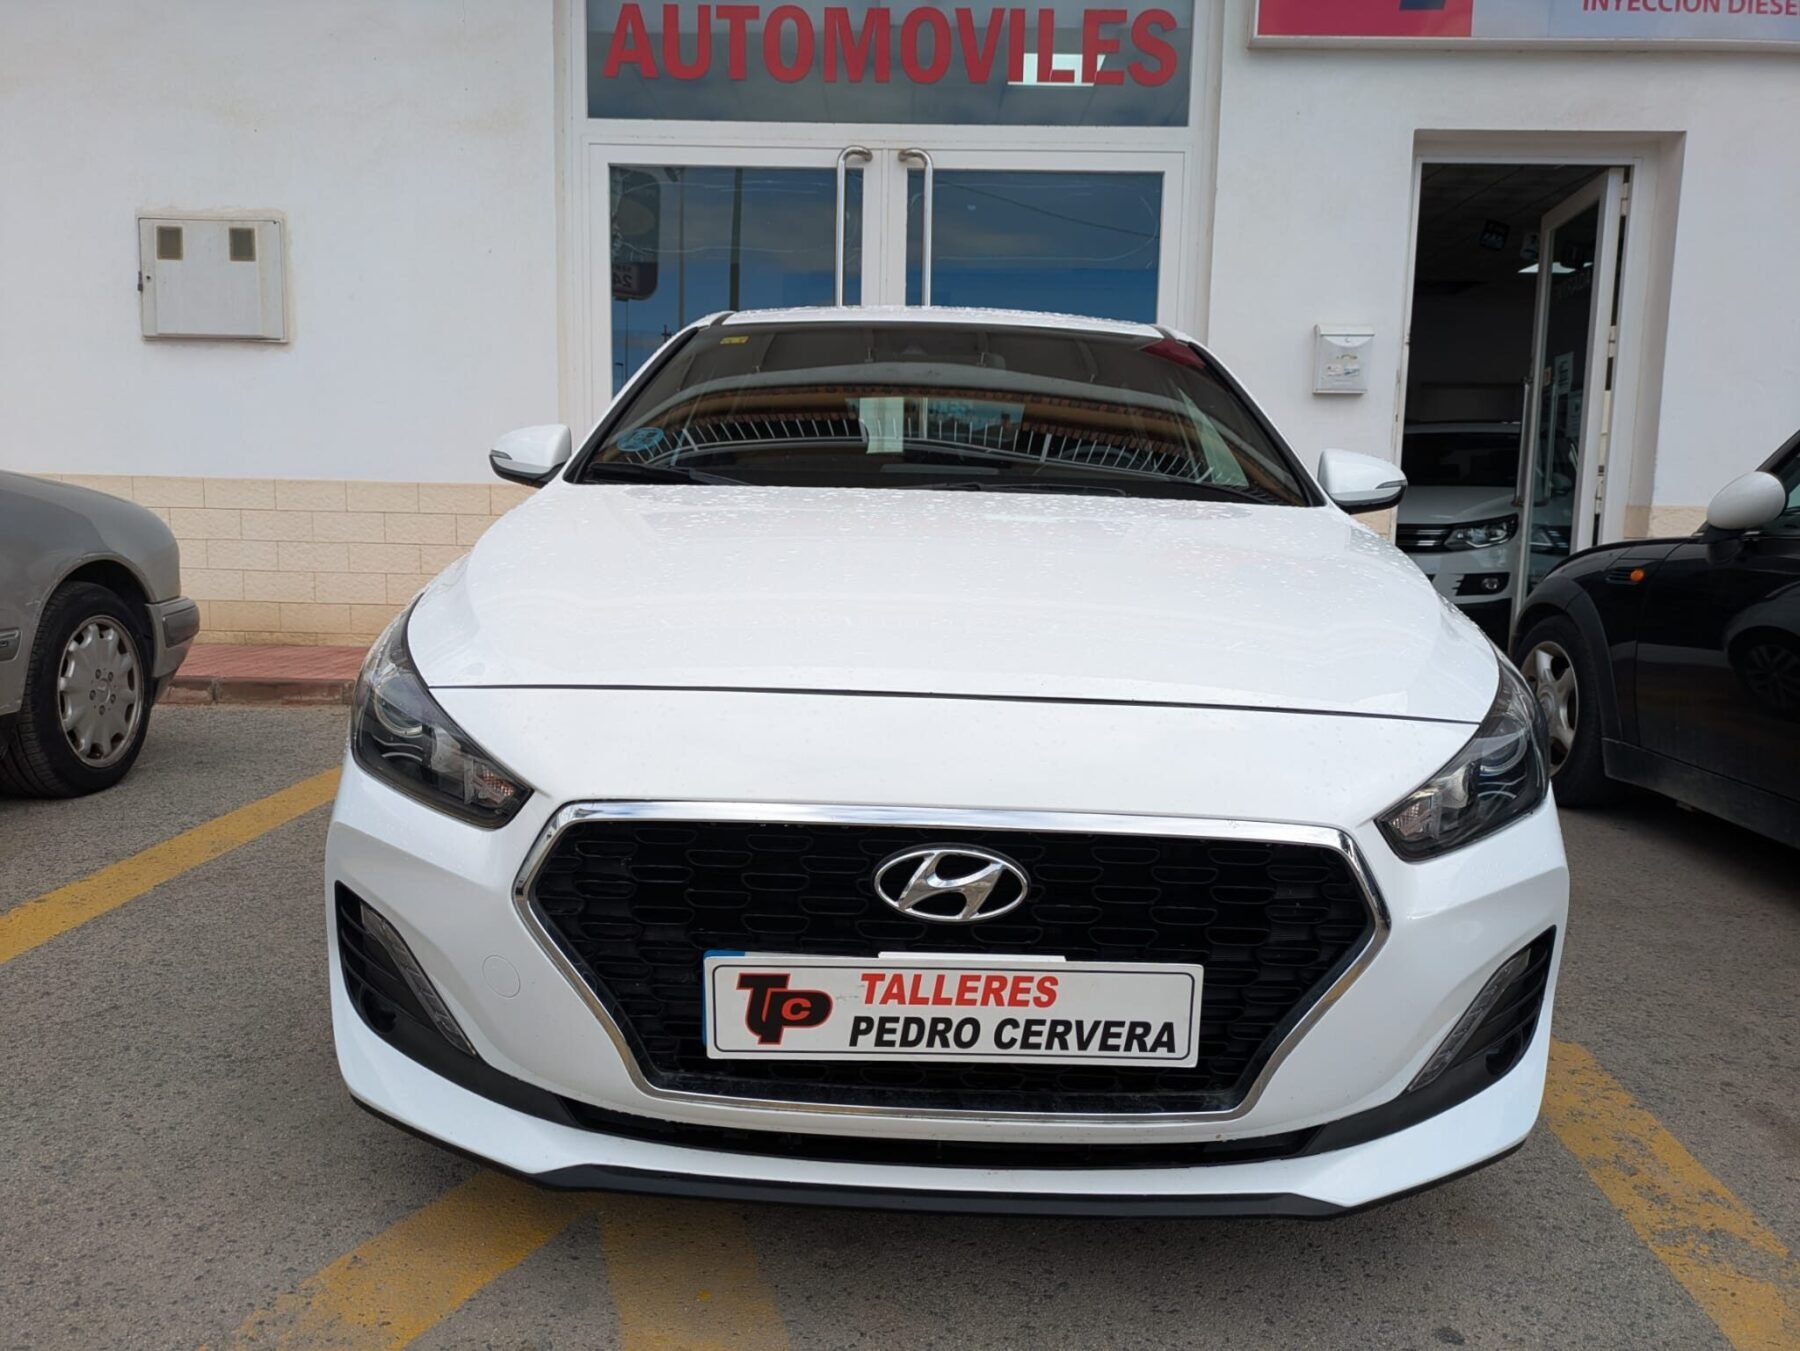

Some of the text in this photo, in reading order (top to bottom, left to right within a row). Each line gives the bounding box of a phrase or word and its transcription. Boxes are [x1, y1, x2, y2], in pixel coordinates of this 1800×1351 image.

[604, 3, 1177, 87] AUTOMOVILES
[861, 973, 1059, 1008] TALLERES
[849, 1016, 1176, 1053] PEDRO CERVERA
